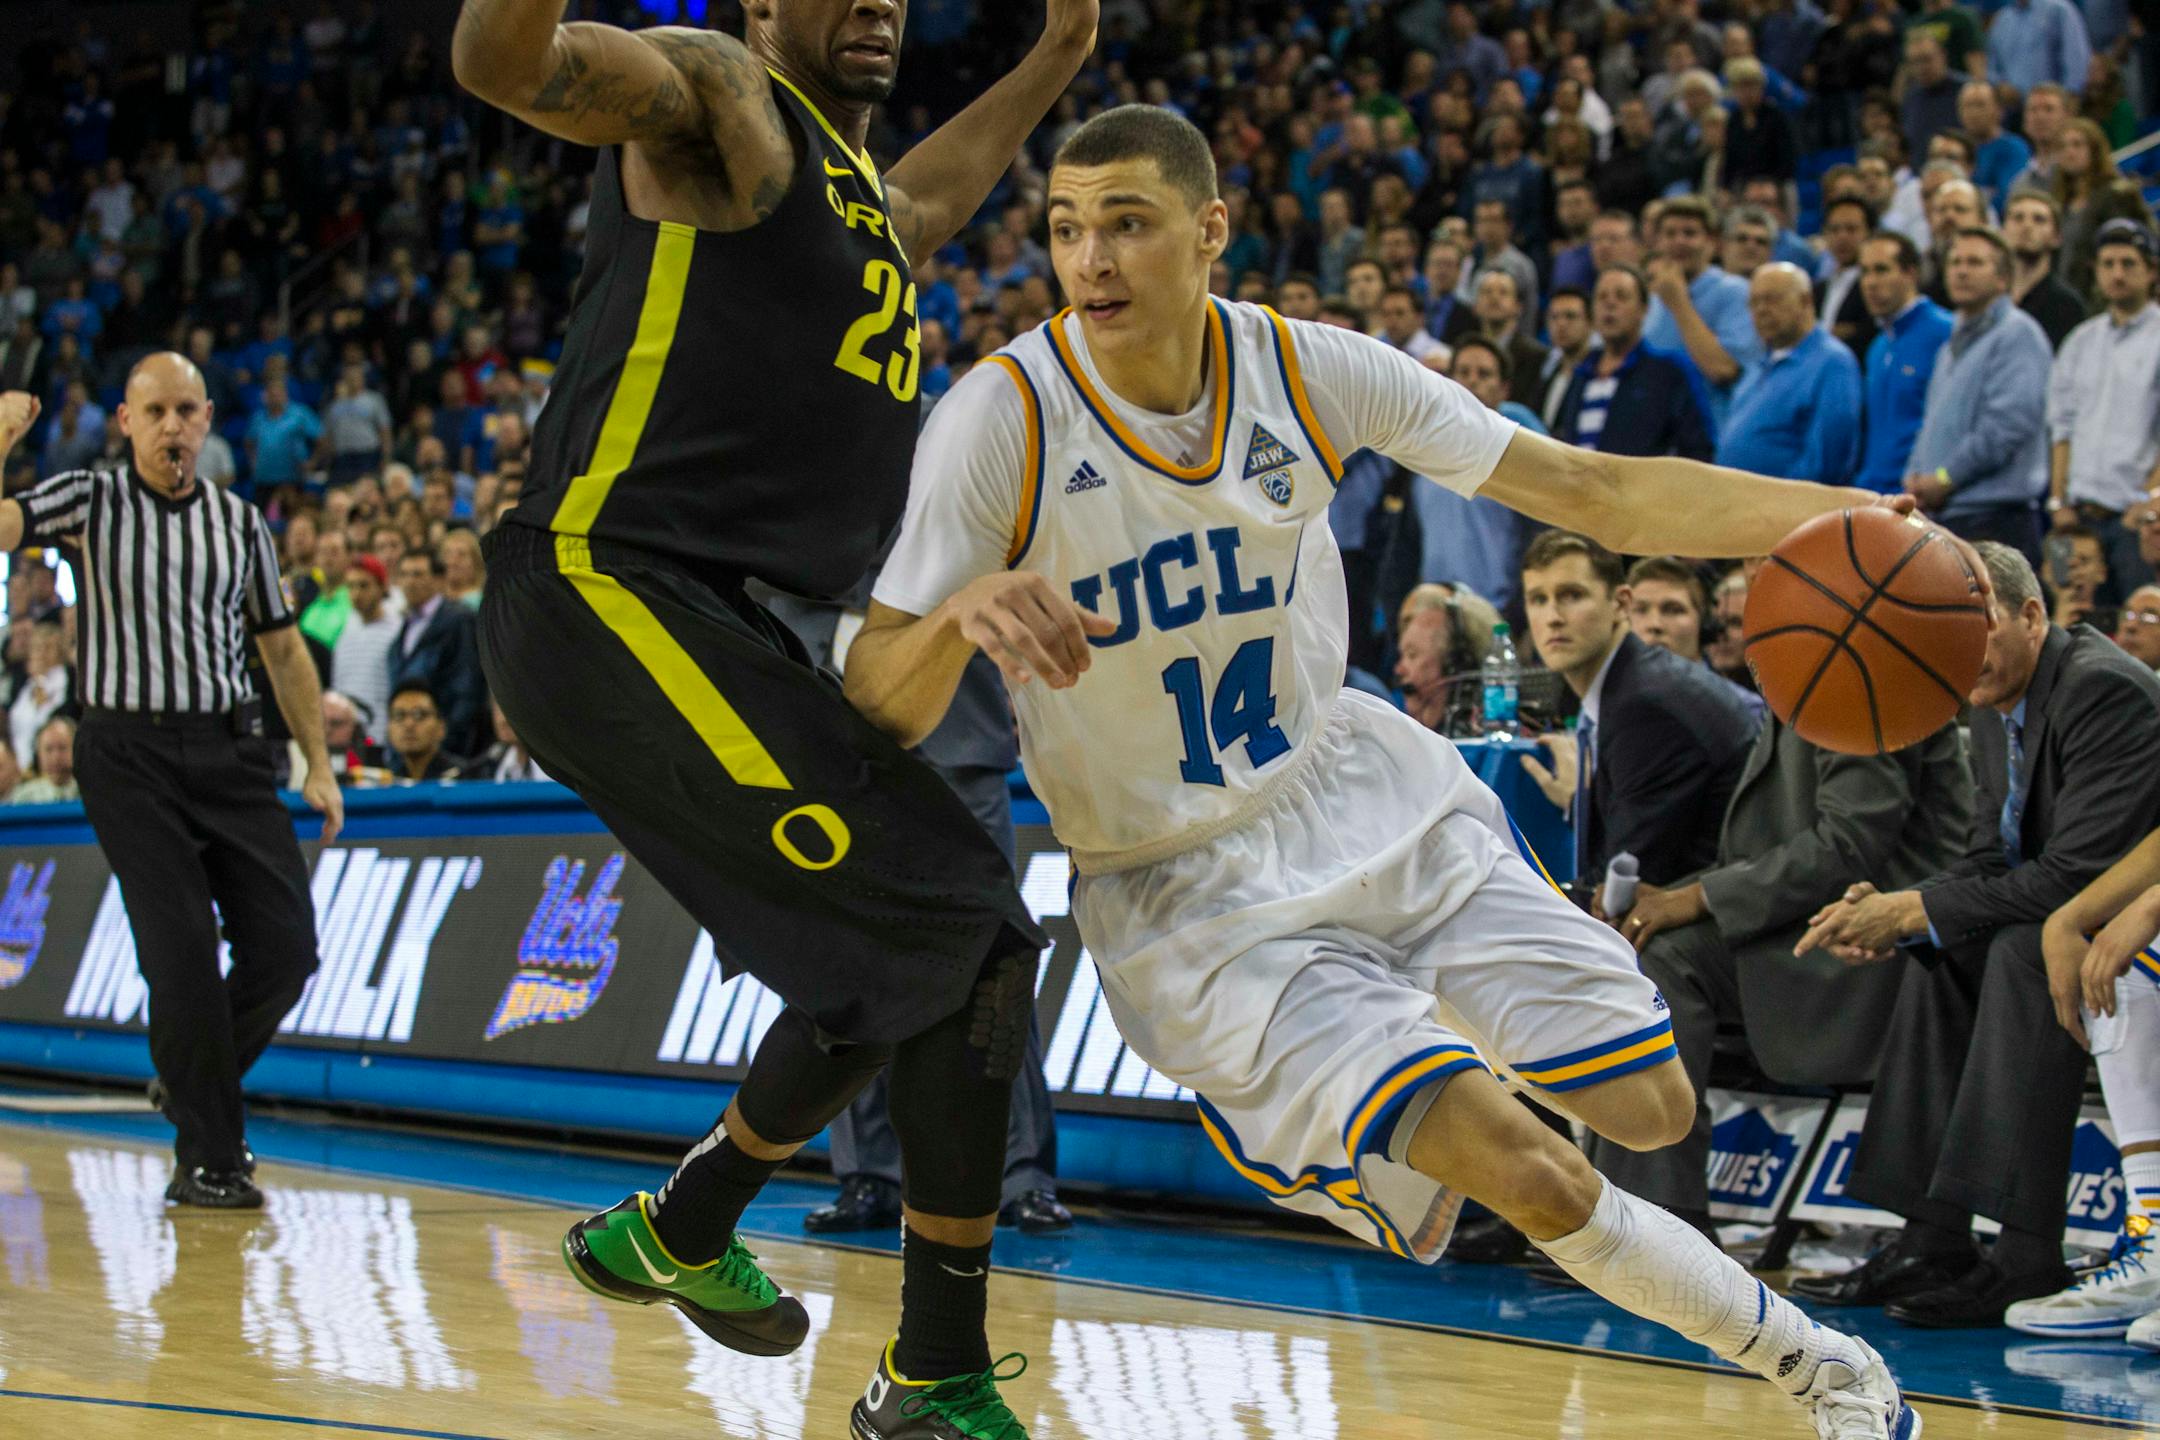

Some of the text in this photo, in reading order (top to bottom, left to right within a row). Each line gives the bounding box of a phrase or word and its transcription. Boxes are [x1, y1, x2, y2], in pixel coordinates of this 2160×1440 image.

[834, 259, 921, 402] 23
[1065, 477, 1107, 494] adidas
[1071, 522, 1304, 648] UCL
[1162, 636, 1291, 787] 14
